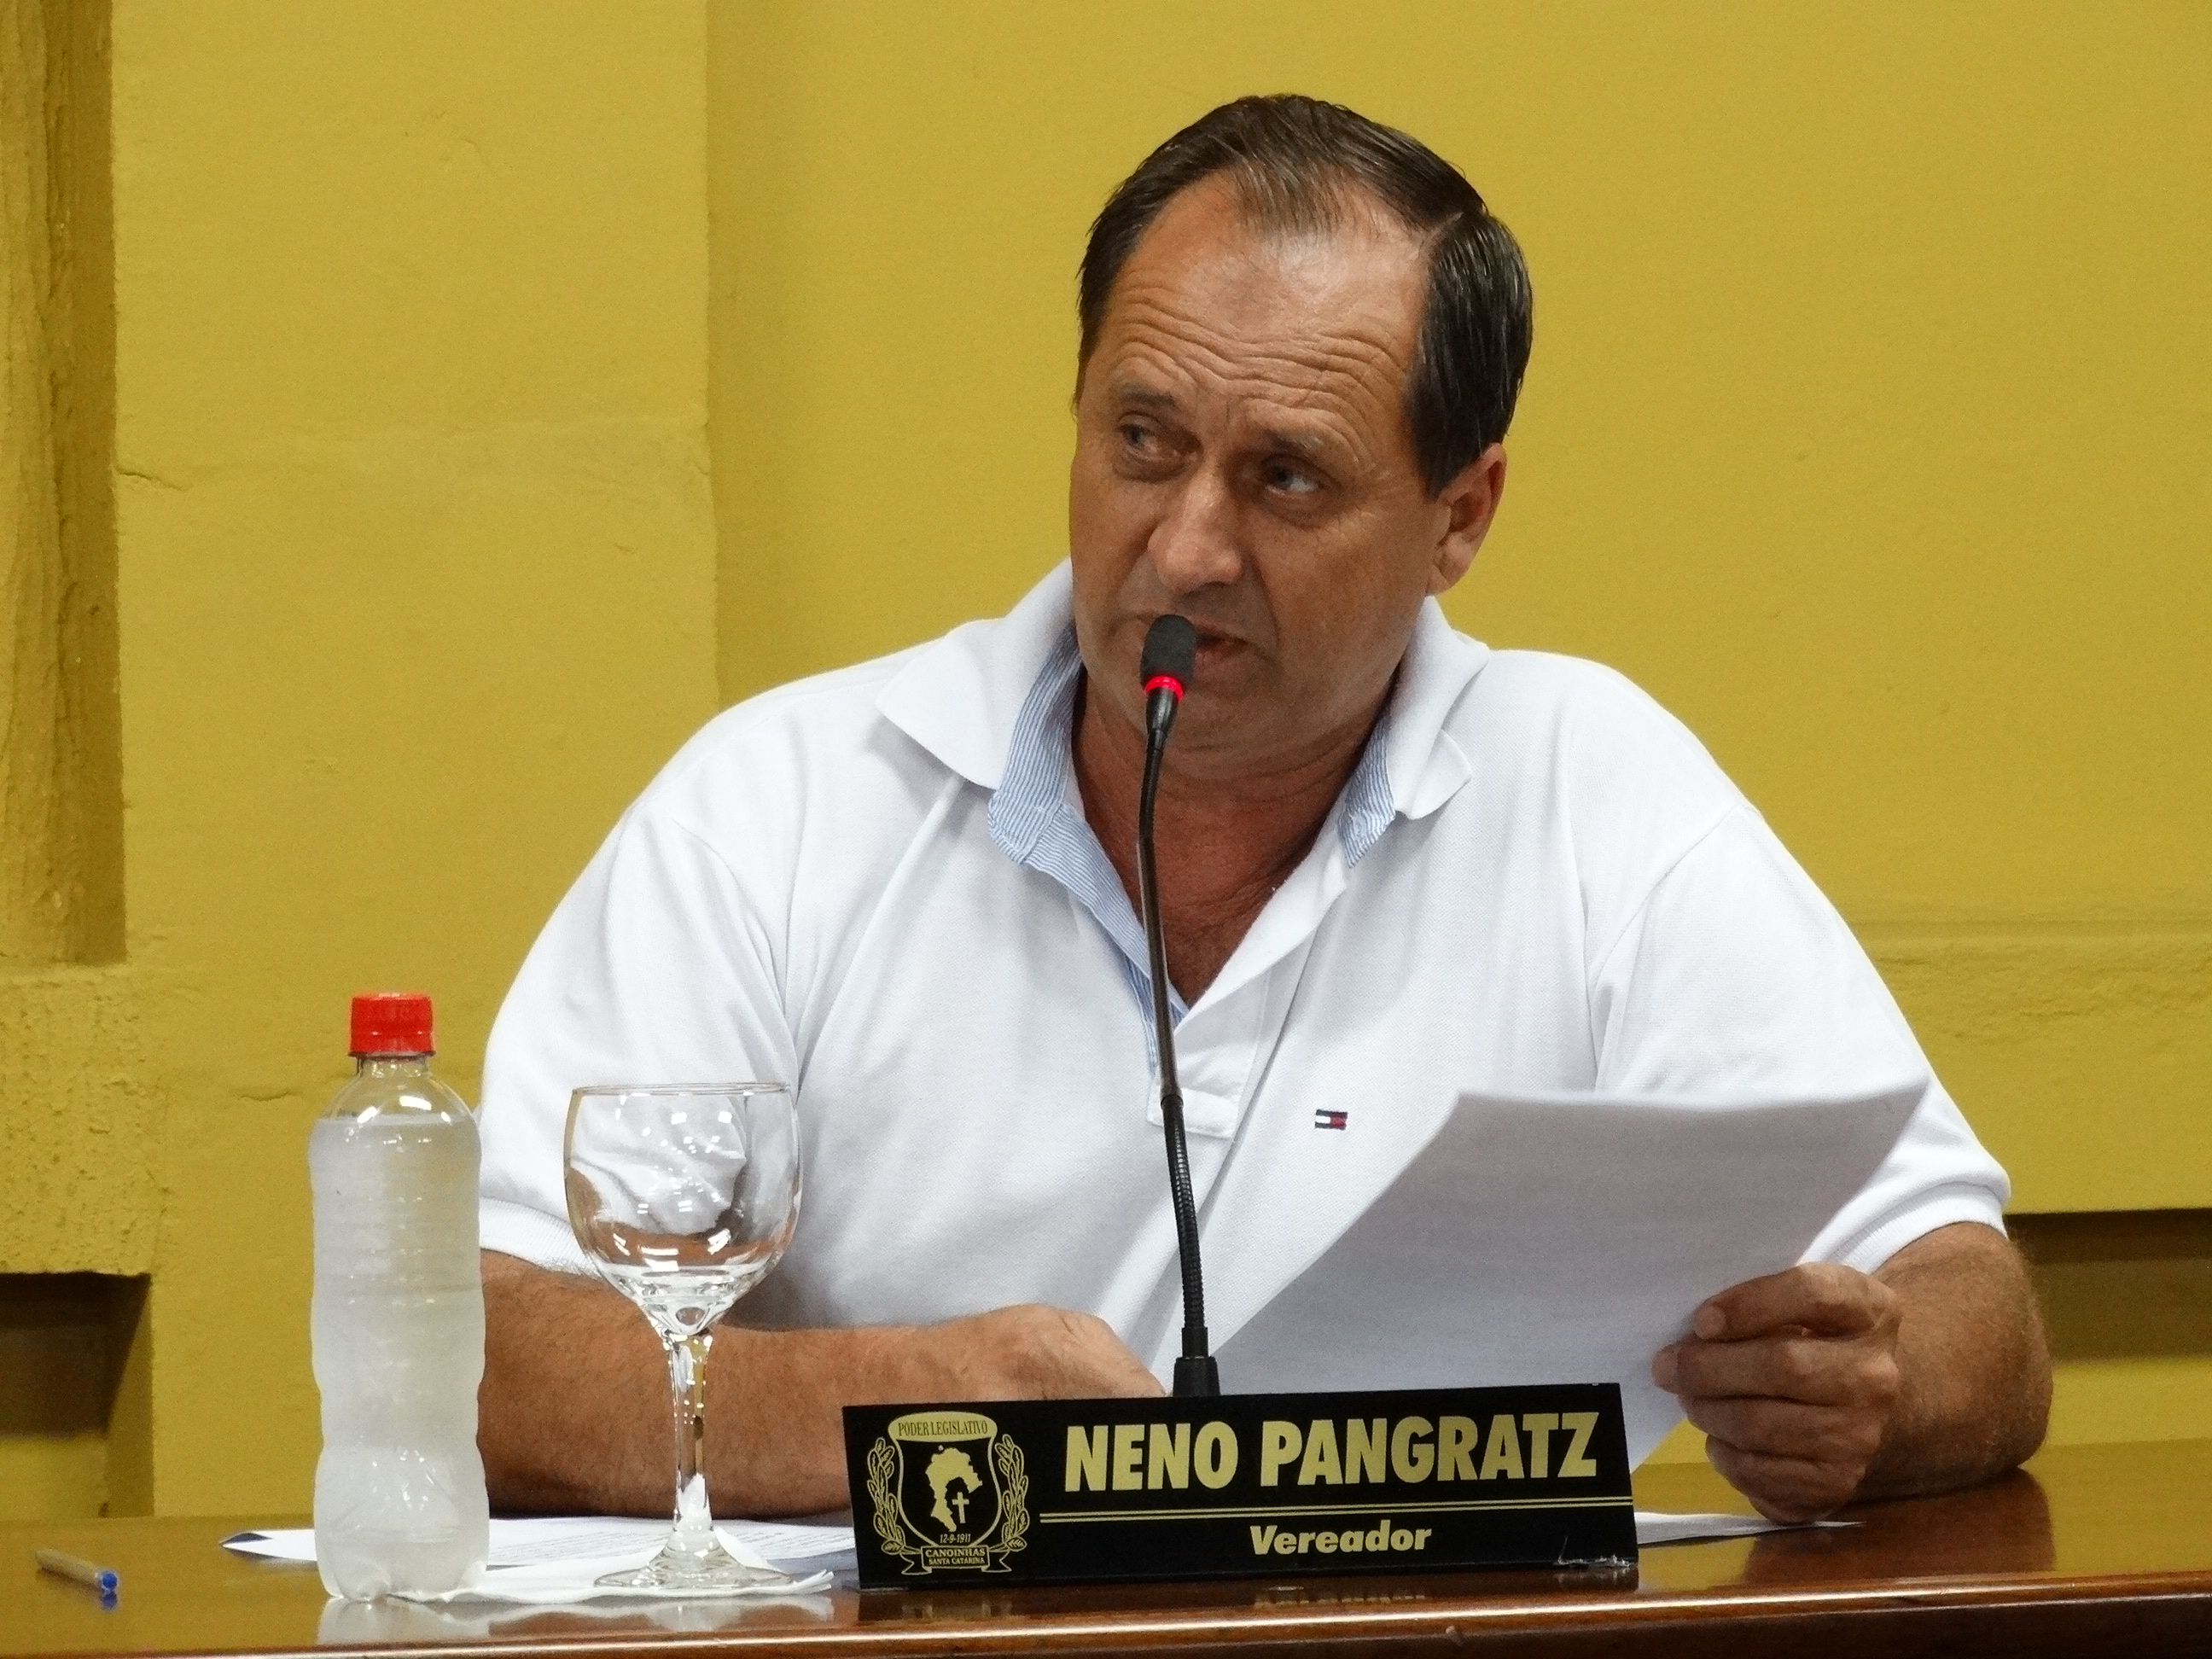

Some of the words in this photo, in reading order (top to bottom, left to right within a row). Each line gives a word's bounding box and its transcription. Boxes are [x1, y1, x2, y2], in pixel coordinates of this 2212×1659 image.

[898, 1422, 930, 1436] PODER
[930, 1420, 988, 1435] LEGISLATIVO
[1064, 1420, 1239, 1492] NENO
[1260, 1412, 1598, 1487] PANGRATZ
[940, 1534, 971, 1544] 12-9-1911
[1250, 1520, 1432, 1555] Vereador
[925, 1548, 986, 1557] CANOINHAS
[951, 1557, 985, 1565] CATARINA
